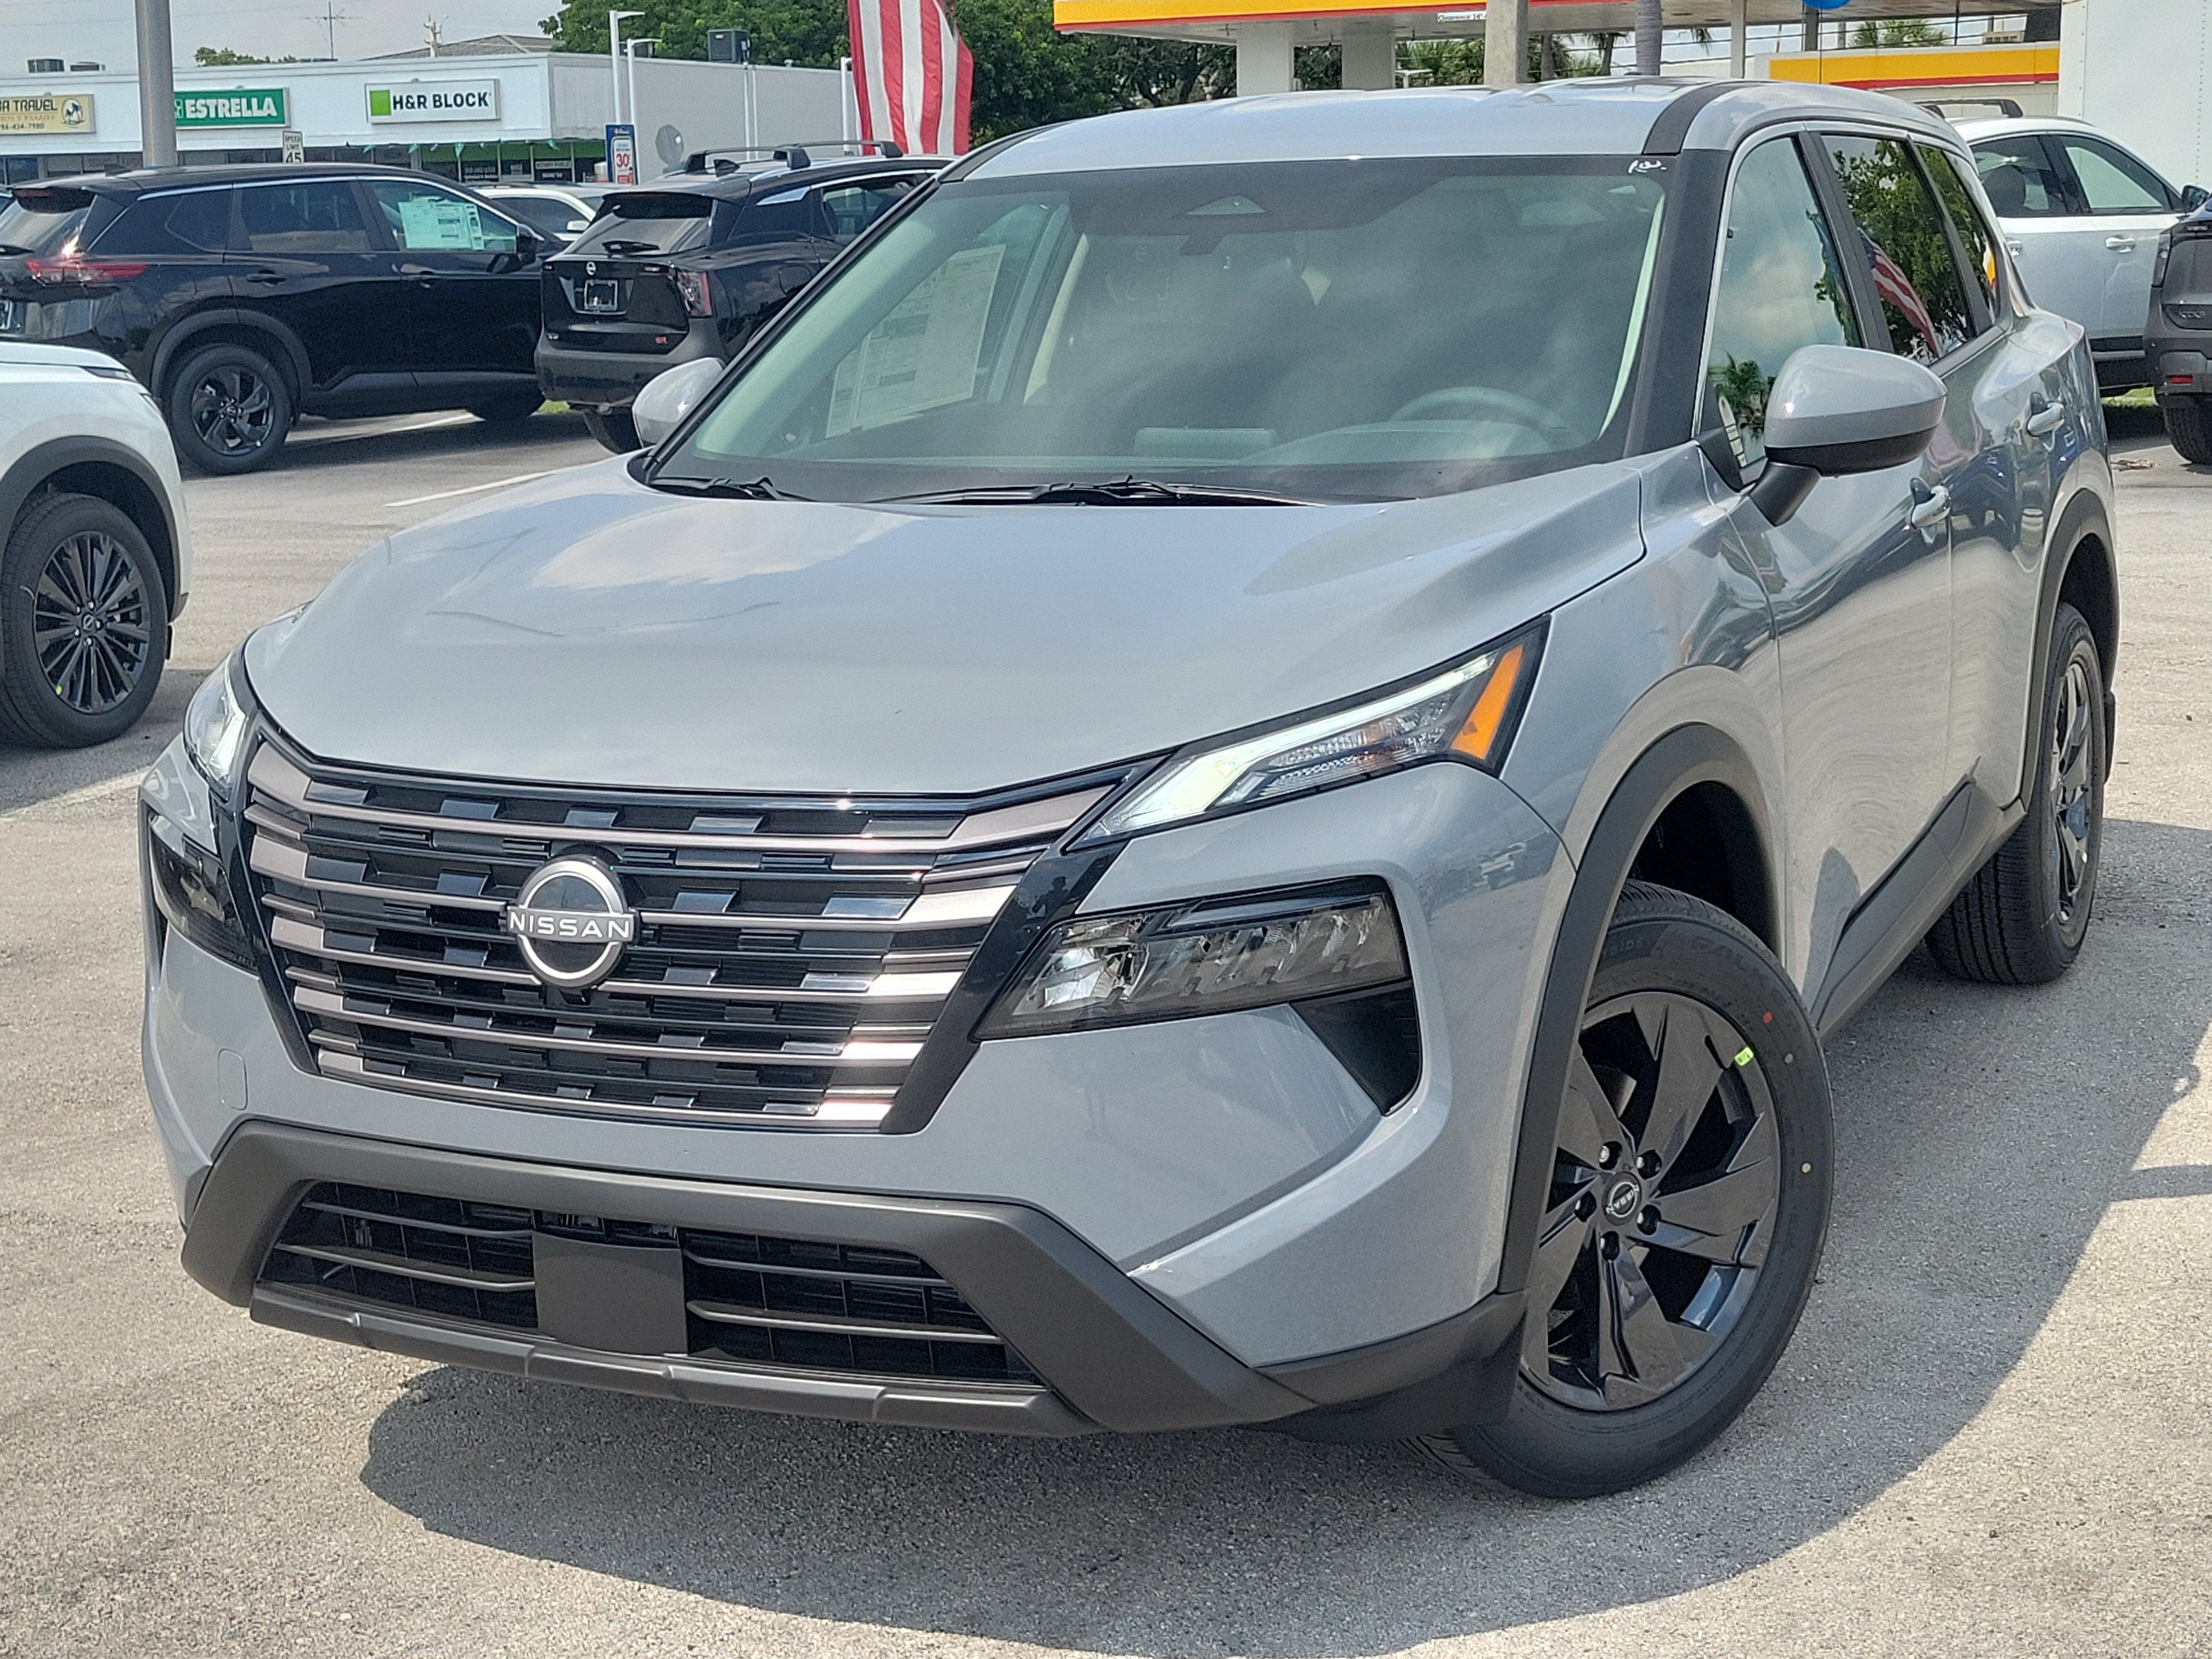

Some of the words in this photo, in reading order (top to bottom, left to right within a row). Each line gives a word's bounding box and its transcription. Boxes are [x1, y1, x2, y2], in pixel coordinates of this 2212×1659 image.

[0, 100, 10, 112] A
[13, 99, 58, 112] TRAVEL
[185, 97, 278, 119] ESTRELLA
[393, 94, 427, 110] H&R
[432, 91, 489, 109] BLOCK
[286, 152, 302, 163] 45
[510, 911, 629, 938] NISSAN
